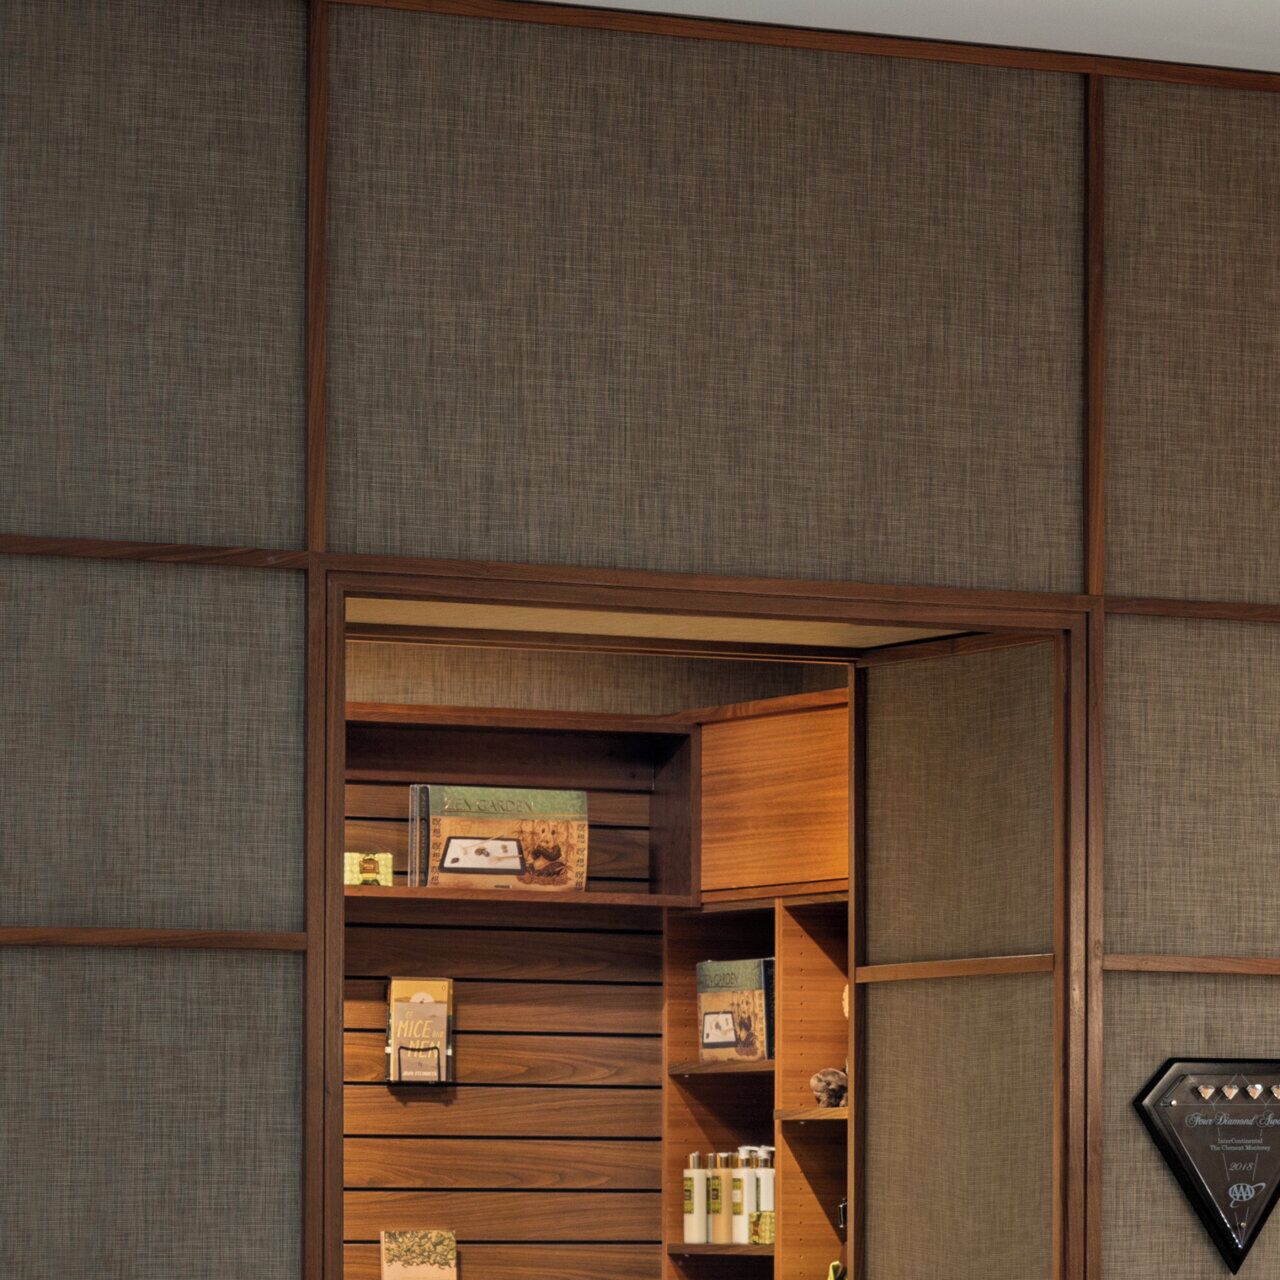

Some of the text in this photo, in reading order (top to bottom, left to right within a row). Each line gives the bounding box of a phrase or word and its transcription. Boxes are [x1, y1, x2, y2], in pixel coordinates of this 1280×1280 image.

[476, 799, 534, 813] GARDEN
[397, 1020, 433, 1038] MICE
[407, 1040, 440, 1058] MEN
[1185, 1112, 1213, 1128] Four
[1214, 1111, 1256, 1126] Diamond
[1229, 1161, 1254, 1171] 2018
[1229, 1183, 1254, 1201] AAA
